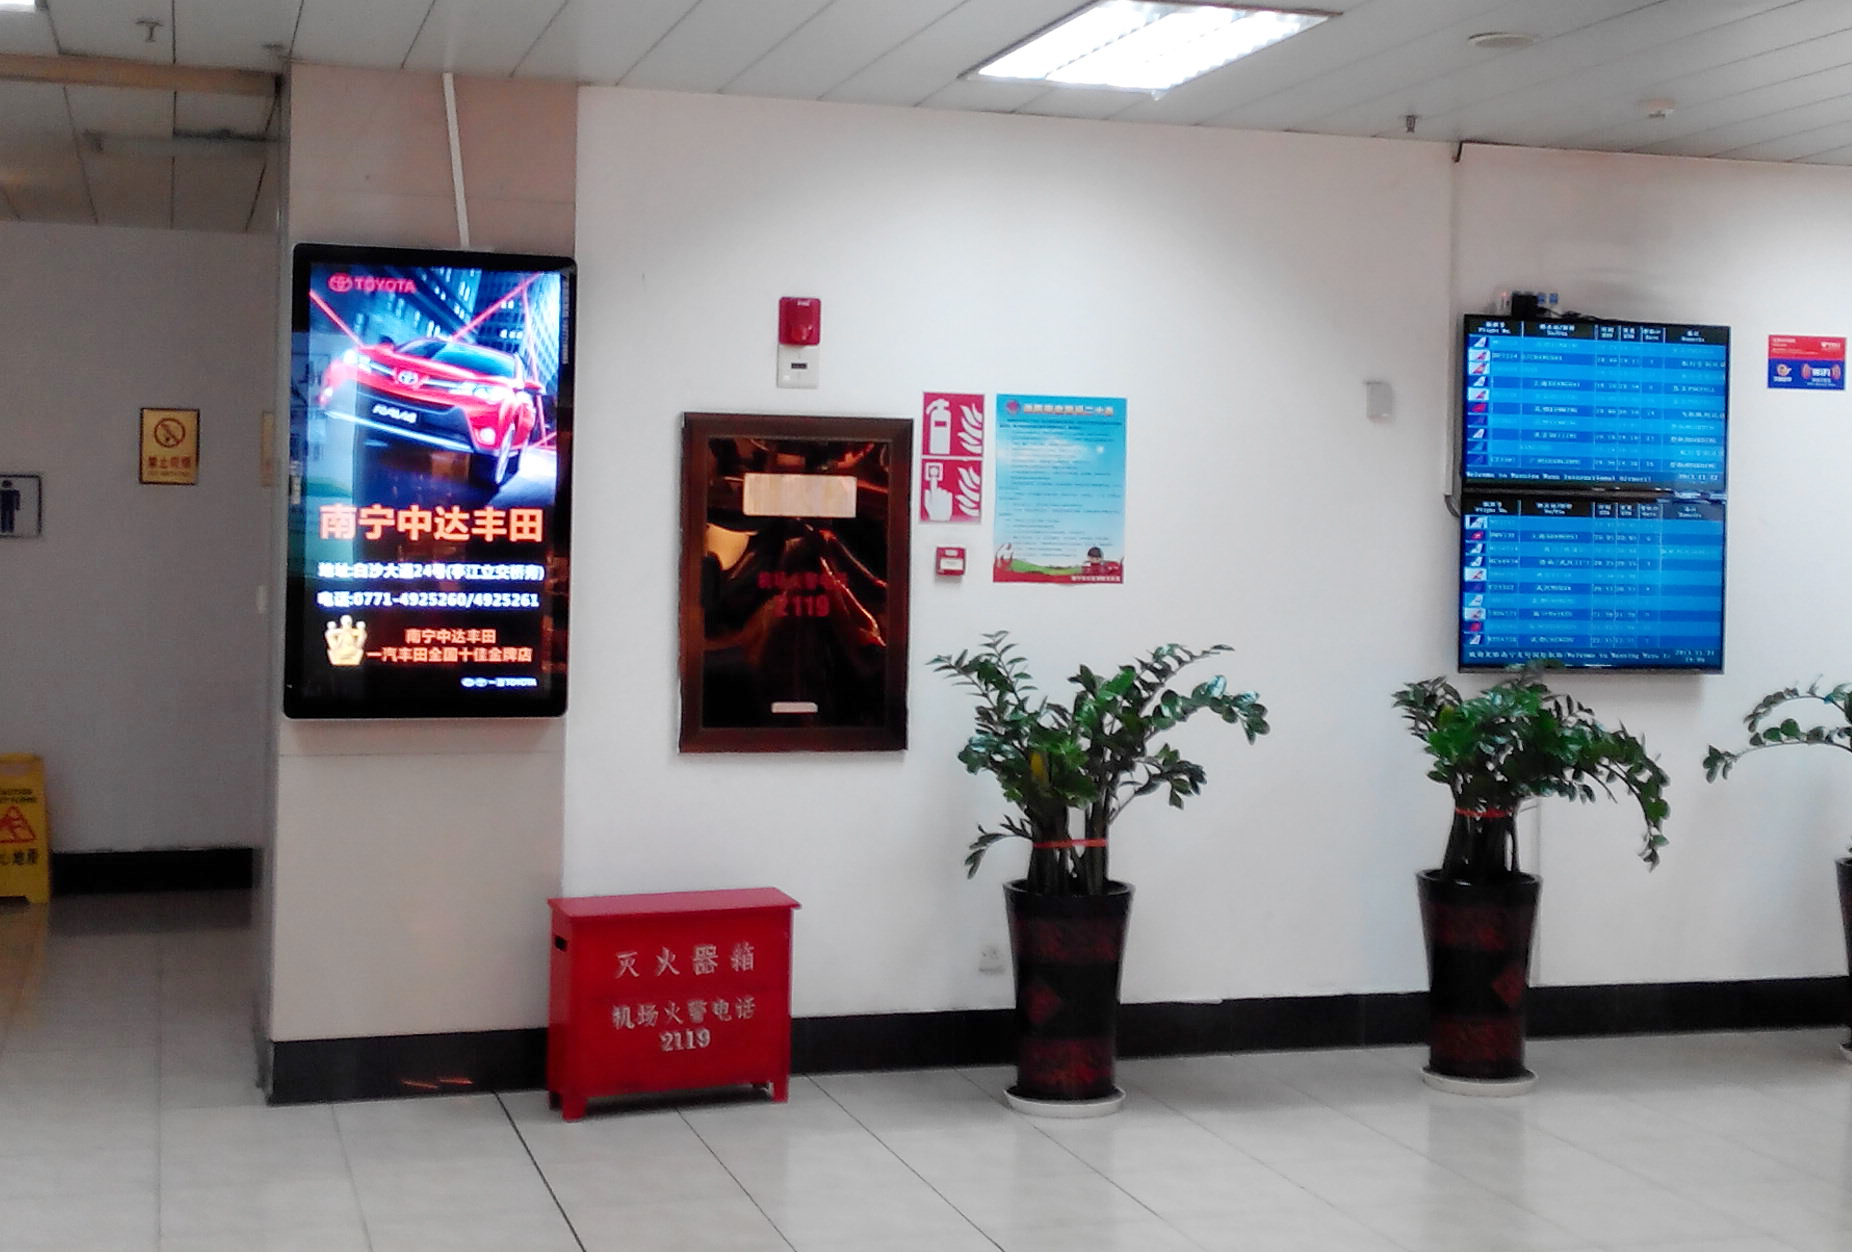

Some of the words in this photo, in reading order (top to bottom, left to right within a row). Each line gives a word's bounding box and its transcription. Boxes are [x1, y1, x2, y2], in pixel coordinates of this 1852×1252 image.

[355, 276, 416, 293] TOYOTA
[319, 504, 544, 542] 南宁中达丰田
[405, 628, 497, 644] 南宁中达丰田
[615, 941, 755, 979] 灭火器箱
[612, 996, 756, 1030] 机场火警电话
[659, 1028, 711, 1052] 2119
